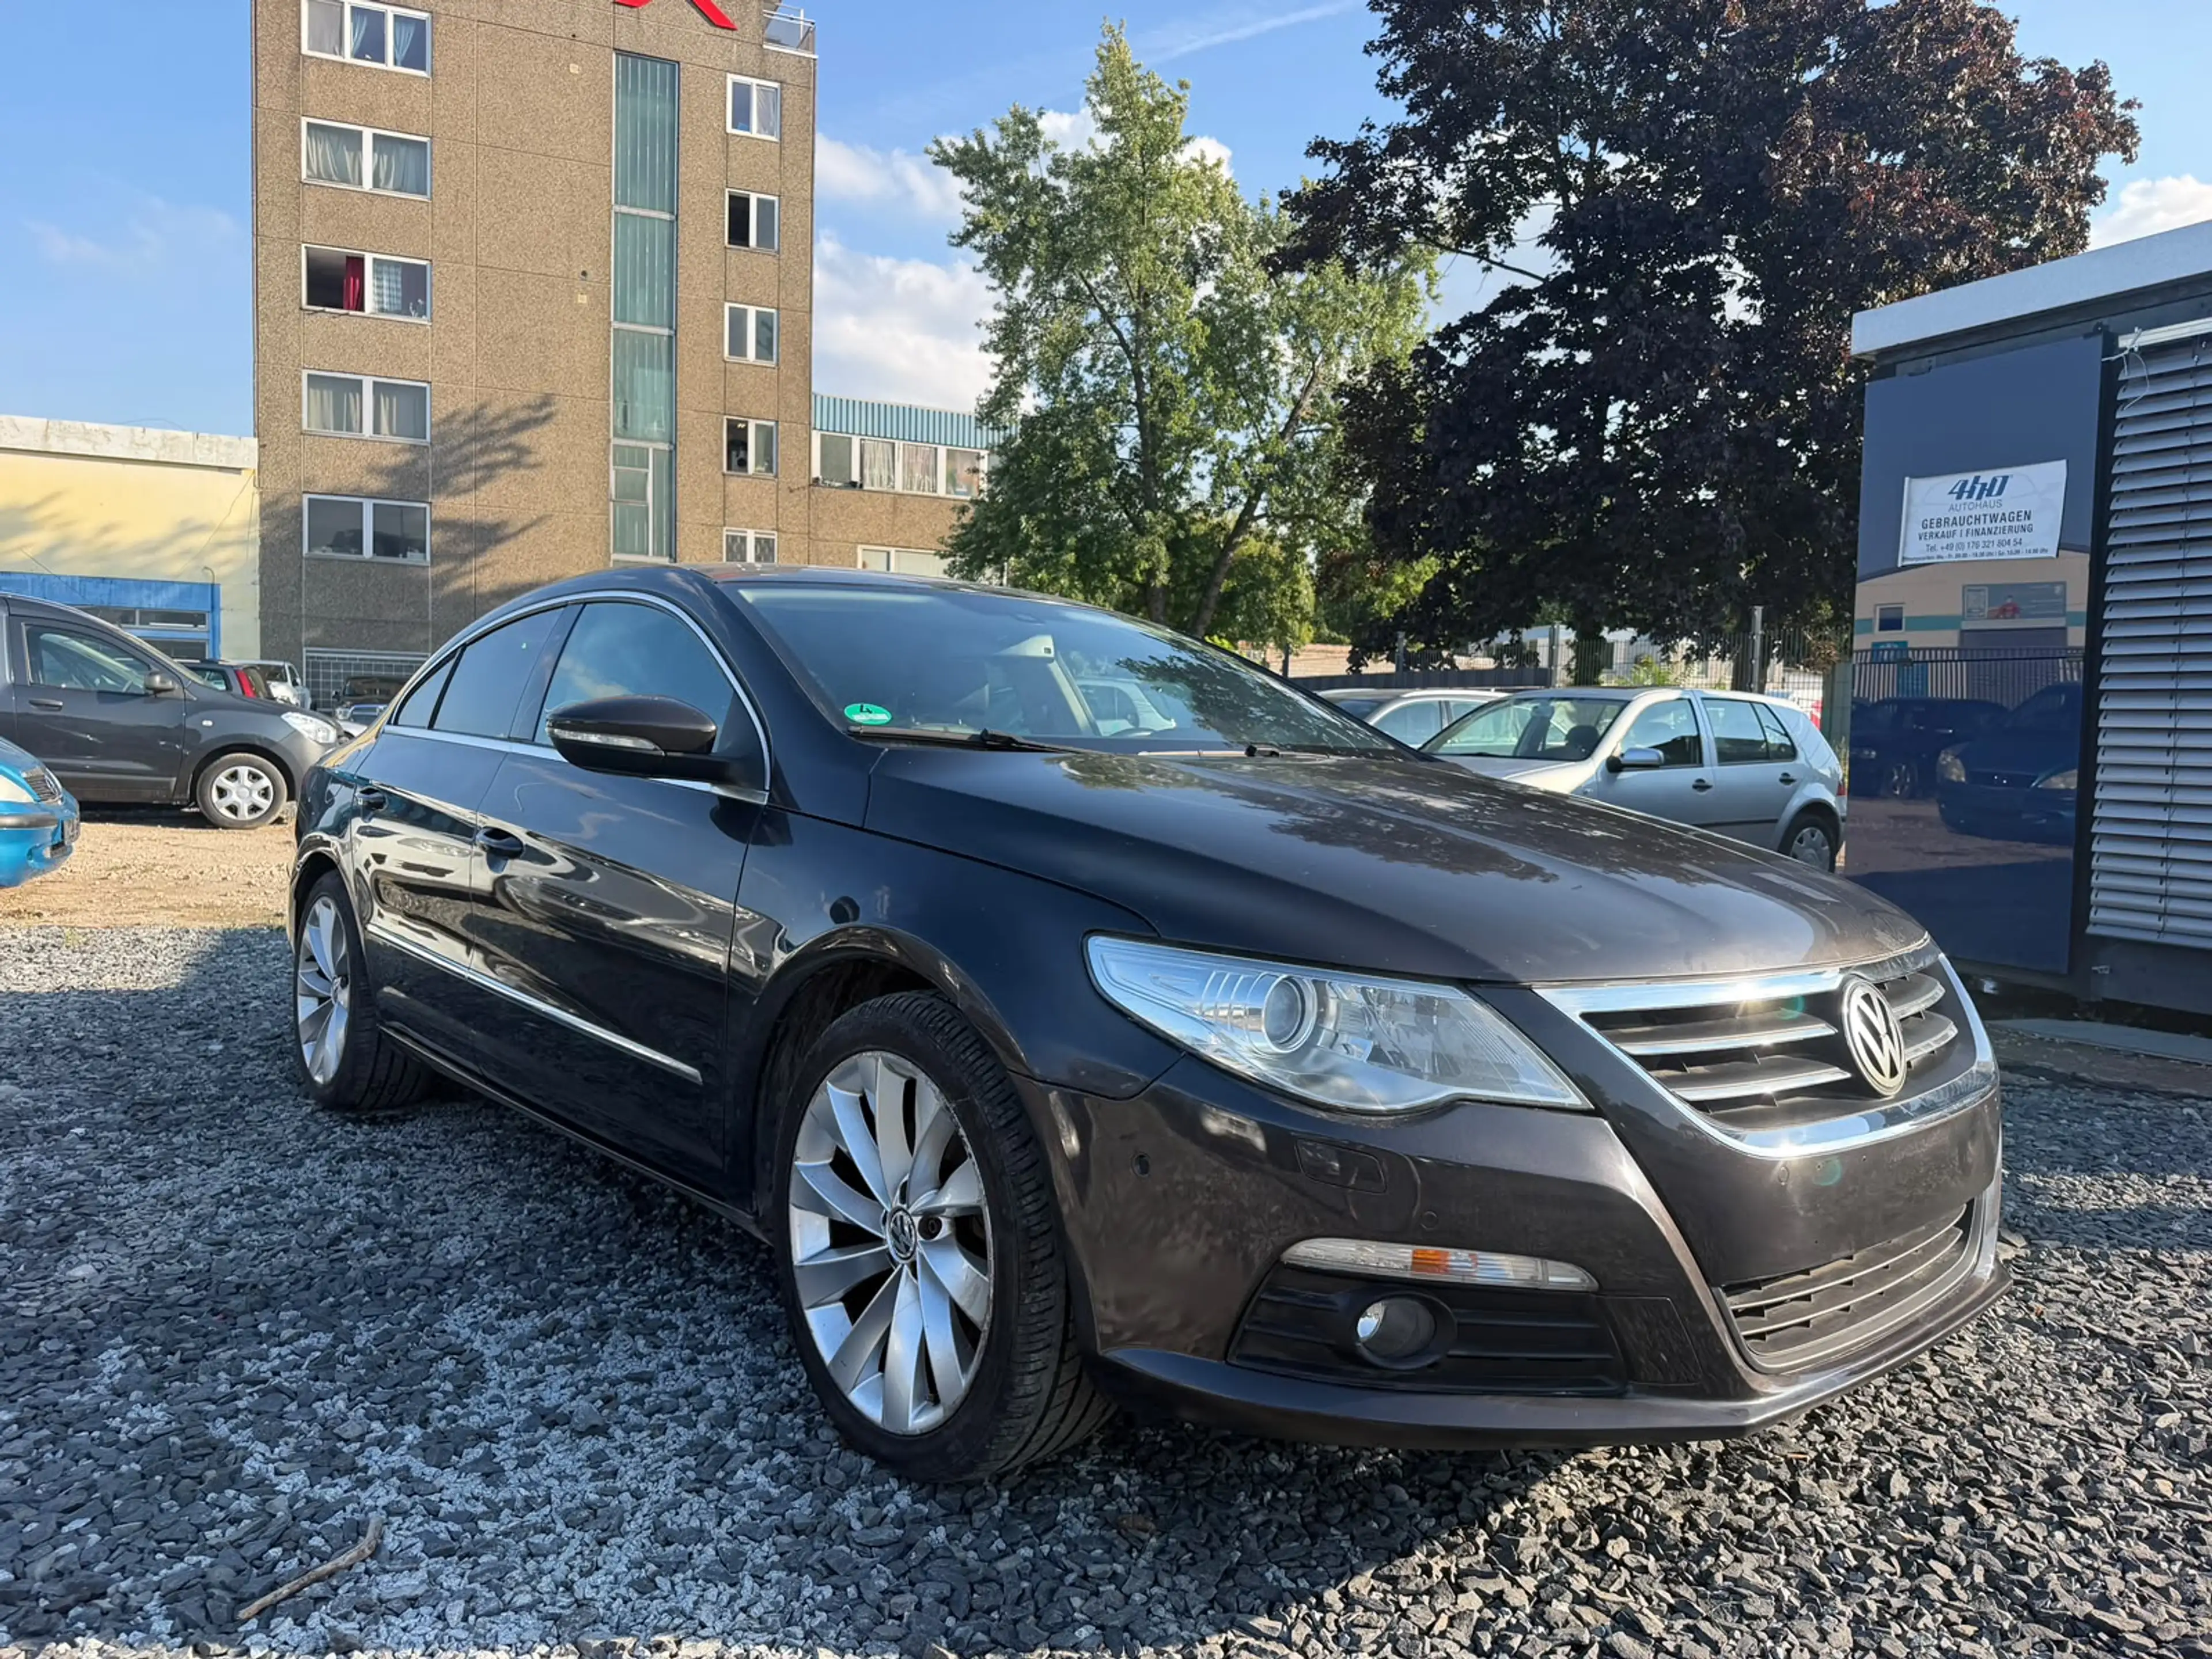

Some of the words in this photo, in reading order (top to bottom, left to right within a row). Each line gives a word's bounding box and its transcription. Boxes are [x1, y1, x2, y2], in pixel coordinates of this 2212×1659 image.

[1948, 499, 2002, 512] AUTOHAUS
[1922, 510, 2032, 529] GEBRAUCHTWAGEN
[1918, 529, 1957, 541] VERKAUF
[1965, 524, 2033, 538] FINANZIERUNG
[1926, 543, 1938, 552] Tel.
[1941, 543, 1954, 551] +49
[1955, 541, 1965, 552] (0)
[1982, 540, 1994, 548] 321
